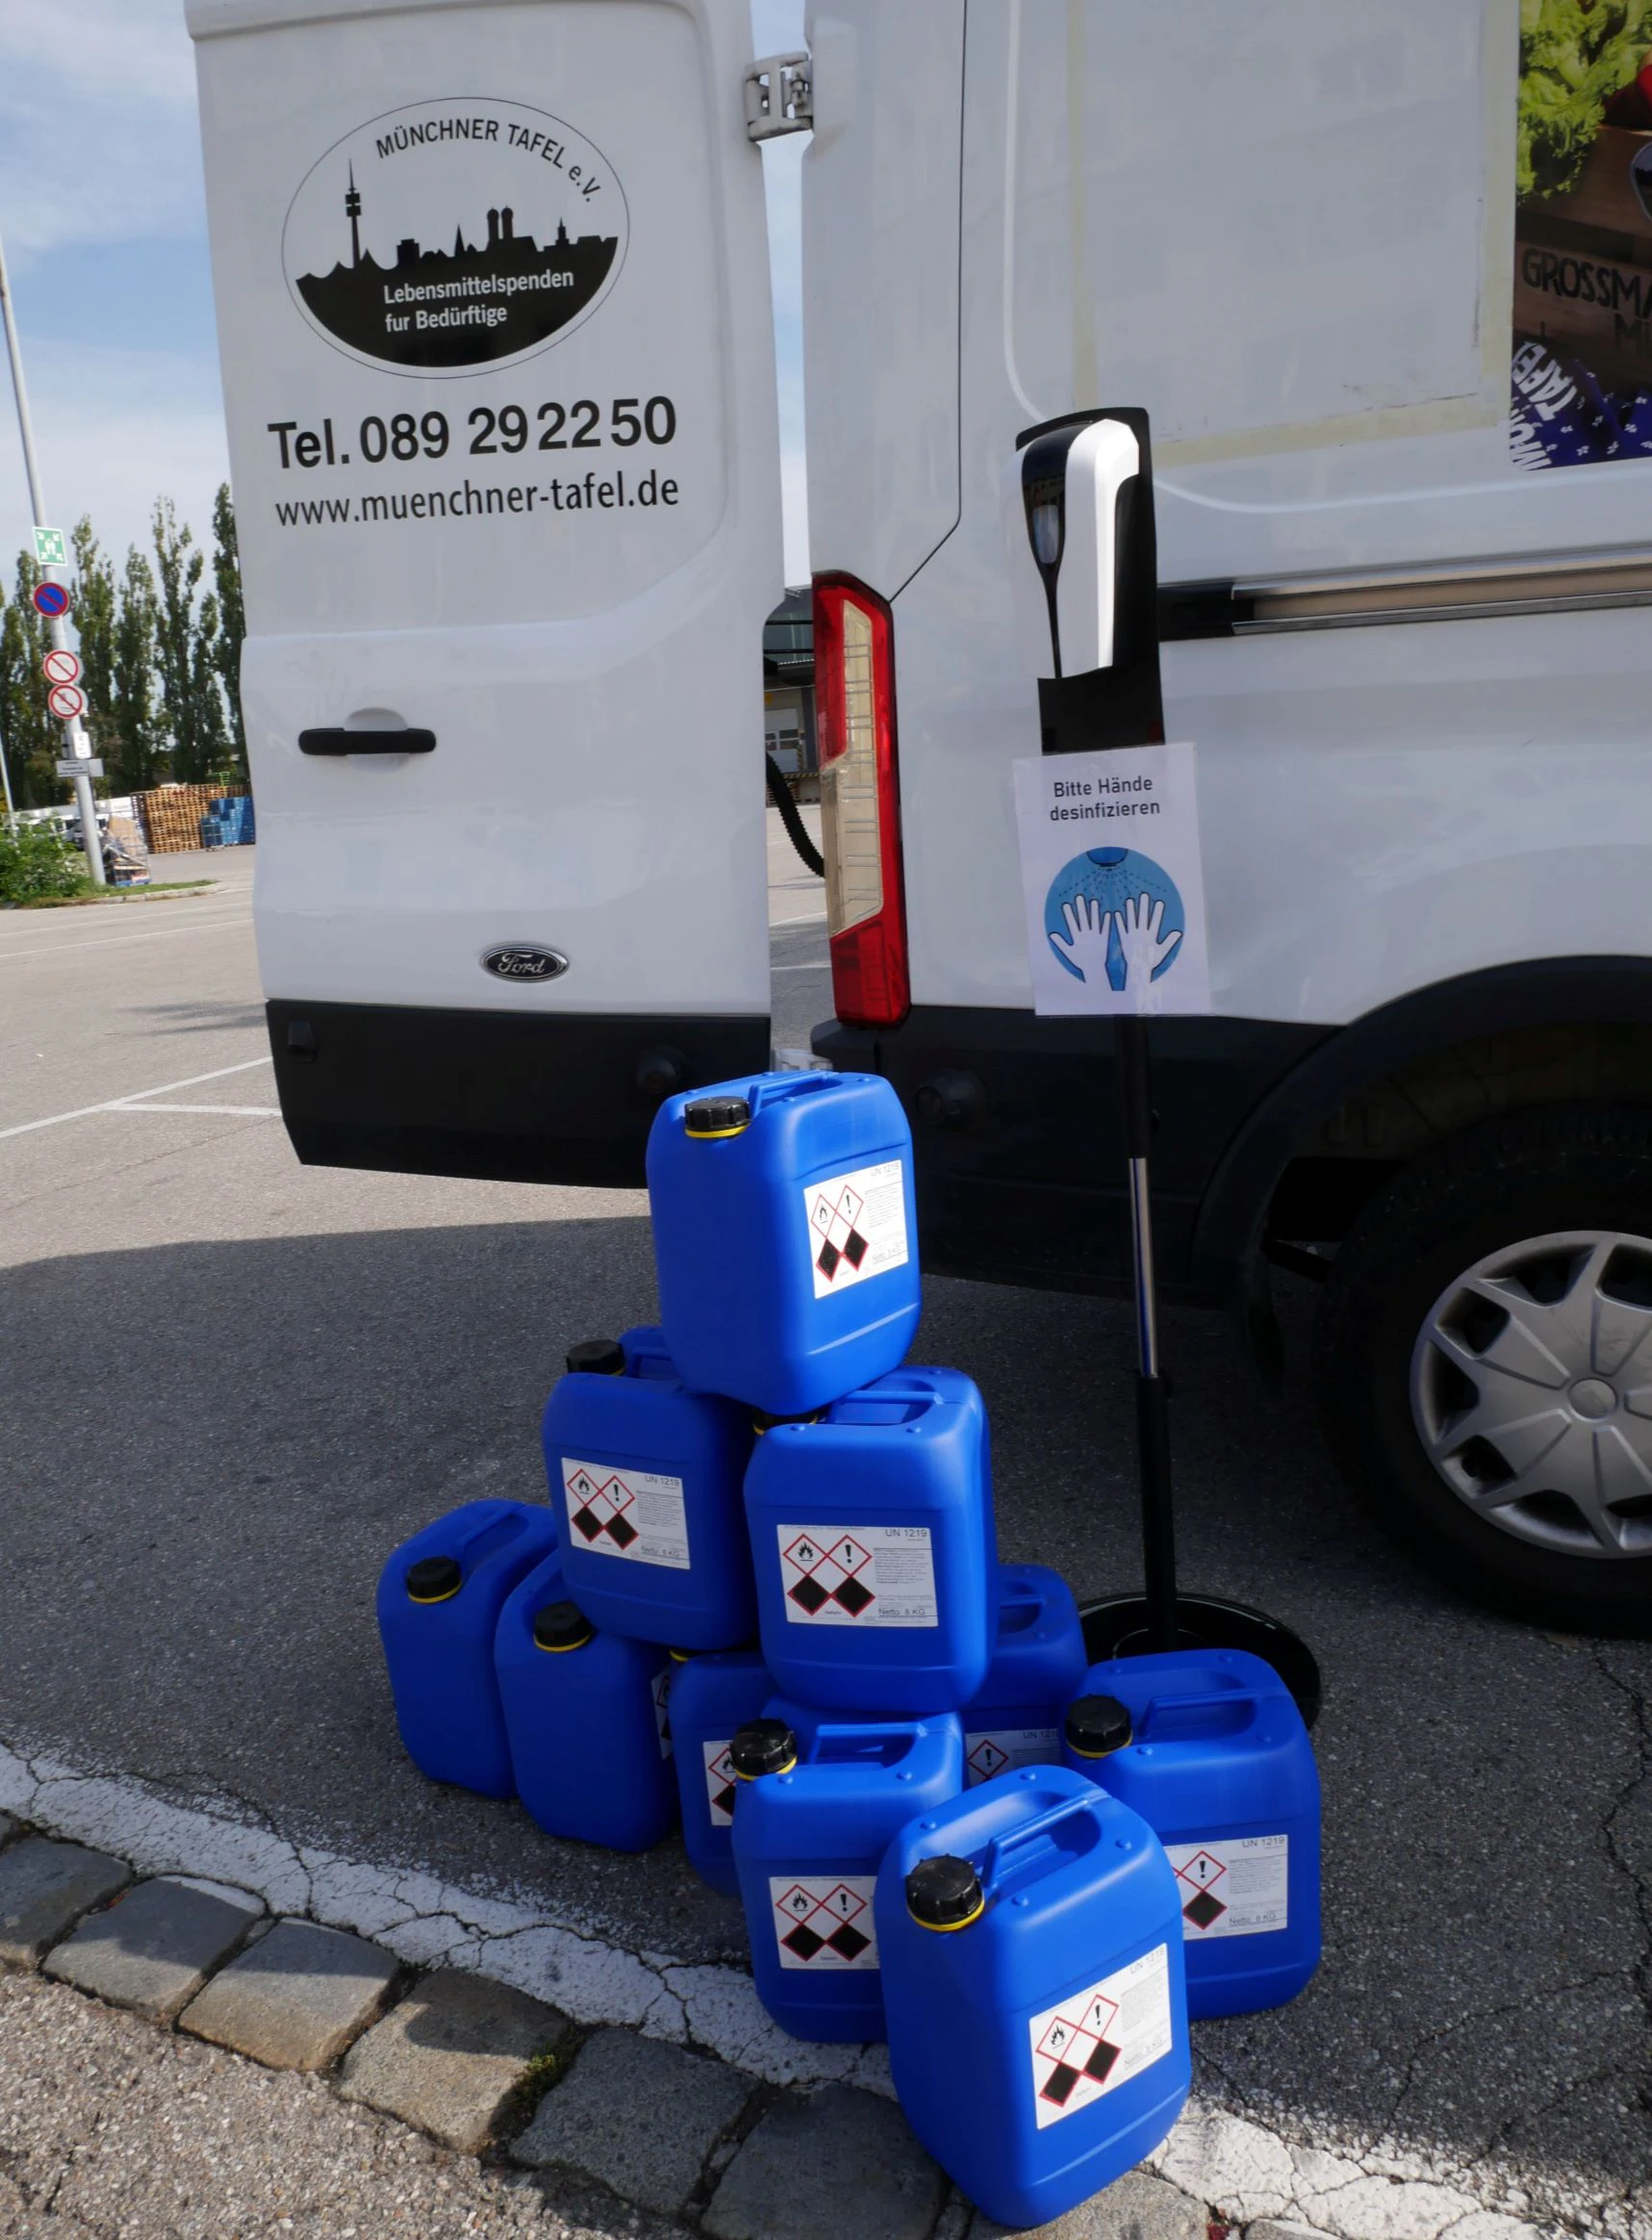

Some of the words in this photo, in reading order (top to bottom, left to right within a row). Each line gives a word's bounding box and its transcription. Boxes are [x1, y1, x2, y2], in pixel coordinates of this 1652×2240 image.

[375, 118, 499, 159] MÜNCHNER
[507, 123, 566, 169] TAFEL
[568, 165, 601, 203] e.V.
[383, 268, 574, 304] Lebensmittelspenden
[416, 304, 508, 329] Bedürftige
[267, 418, 350, 469] Tel.
[360, 410, 449, 463] 089
[275, 469, 678, 527] www.muenchner-tafel.de
[1054, 780, 1092, 798] Bitte
[1098, 775, 1154, 795] Hände
[1050, 801, 1160, 822] desinfizieren
[497, 953, 546, 974] Ford
[645, 1475, 658, 1485] UN
[885, 1529, 901, 1538] UN
[903, 1529, 928, 1538] 1219
[1241, 1839, 1258, 1848] UN
[1260, 1836, 1285, 1846] 1219
